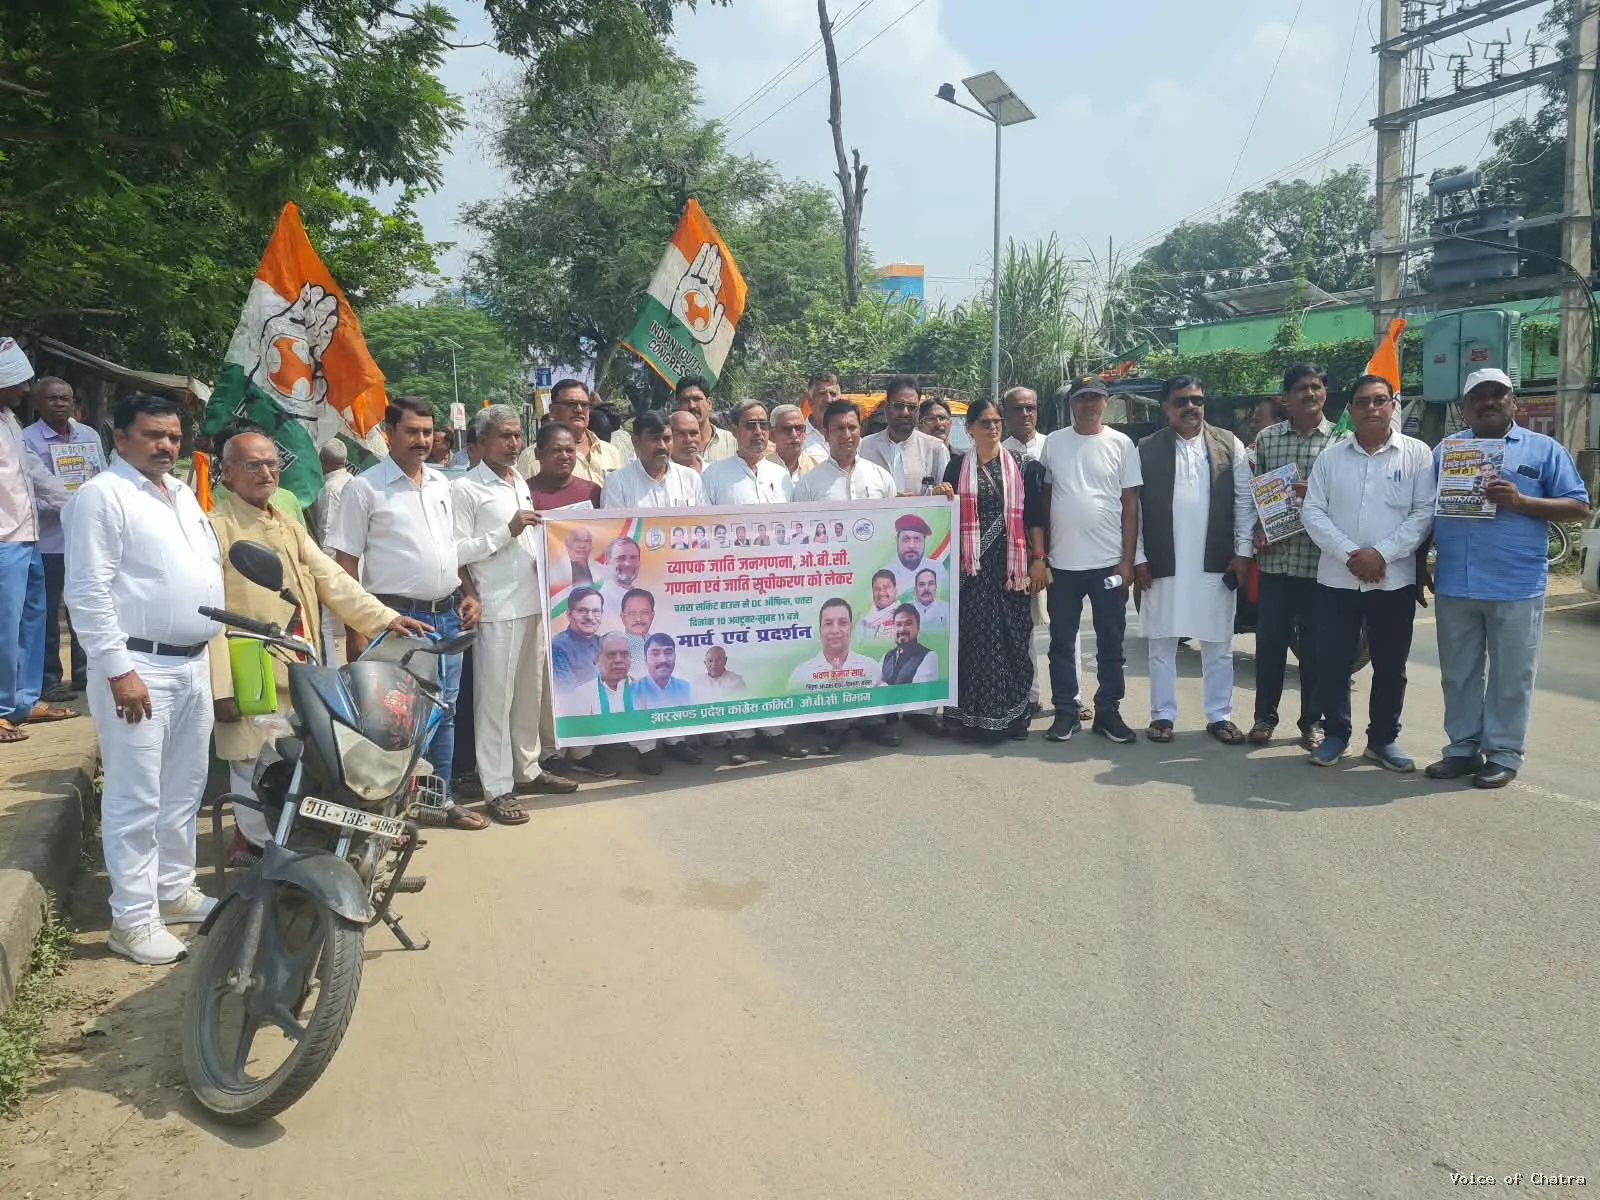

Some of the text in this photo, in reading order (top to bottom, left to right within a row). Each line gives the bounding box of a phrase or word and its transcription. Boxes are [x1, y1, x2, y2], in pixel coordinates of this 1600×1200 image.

[647, 339, 692, 378] CONGRESS
[648, 320, 704, 376] INDIAN YOUTH
[667, 558, 705, 575] व्यापक
[709, 554, 736, 573] जाति
[738, 554, 797, 572] जनगणना,
[664, 570, 854, 596] गणना एवं जाति सूचीकरण को लेकर
[741, 598, 750, 608] से
[688, 617, 715, 627] दिनांक
[717, 616, 726, 625] 10
[777, 612, 785, 621] 11
[786, 611, 800, 621] बजे
[676, 623, 813, 649] मार्च एवं प्रदर्शन
[650, 709, 697, 724] झारखण्ड
[700, 705, 725, 718] प्रदेश
[728, 701, 758, 714] कांग्रेस
[762, 697, 794, 712] कमिटी
[843, 691, 871, 704] विभाग
